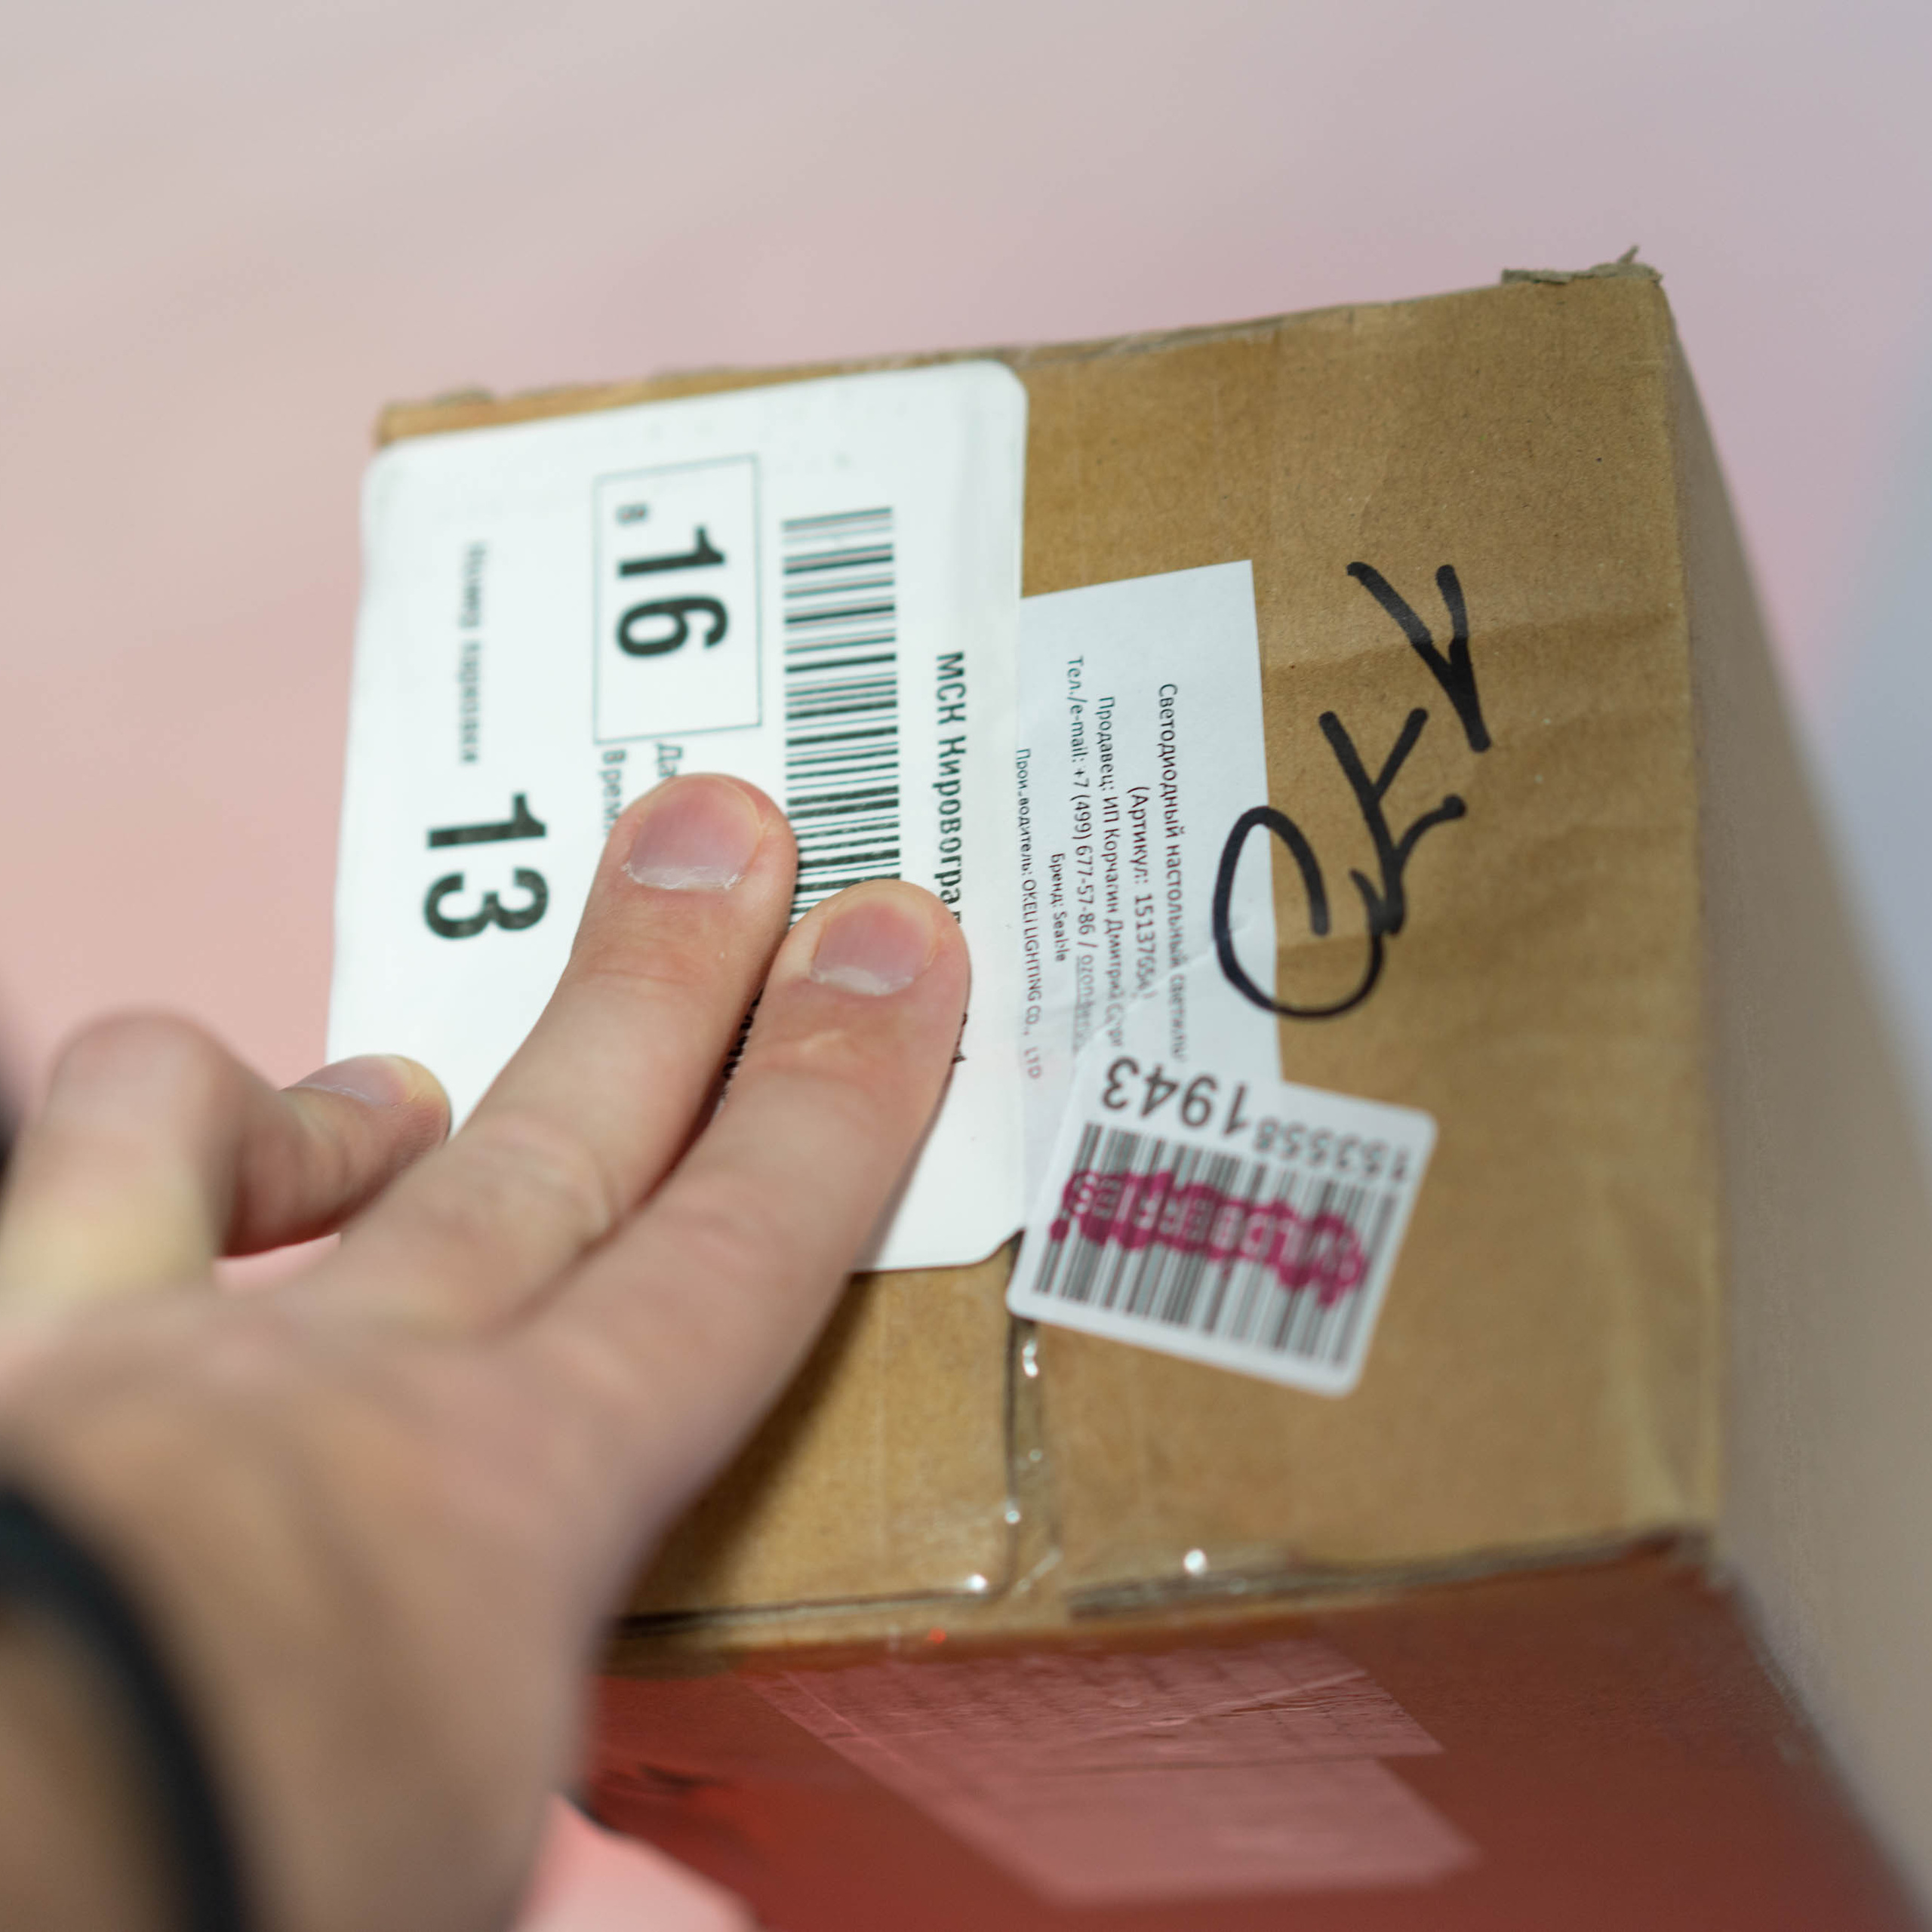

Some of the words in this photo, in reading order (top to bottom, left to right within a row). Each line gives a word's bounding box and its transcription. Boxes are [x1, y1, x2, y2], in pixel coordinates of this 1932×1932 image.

[613, 526, 731, 657] 16
[935, 652, 967, 724] МСК
[1066, 656, 1088, 763] Тел./e-mail:
[1073, 768, 1089, 789] +7
[1094, 696, 1116, 791] Продавец:
[1157, 683, 1186, 838] Светодиодный
[596, 748, 628, 837] Врем
[1016, 747, 1033, 876] Проиводитель:
[1070, 793, 1093, 841] (499)
[1101, 795, 1119, 824] ИП
[1127, 786, 1150, 884] (Артикул:
[421, 790, 551, 942] 13
[1049, 853, 1066, 908] Бренд:
[1075, 845, 1096, 936] 677-57-86
[1101, 829, 1121, 913] Корчагин
[1165, 844, 1189, 969] настольный
[1023, 927, 1042, 1001] LIGHTING
[1104, 918, 1124, 1001] Дмитрий
[1023, 1046, 1043, 1080] LTD
[1100, 1057, 1253, 1136] 1943
